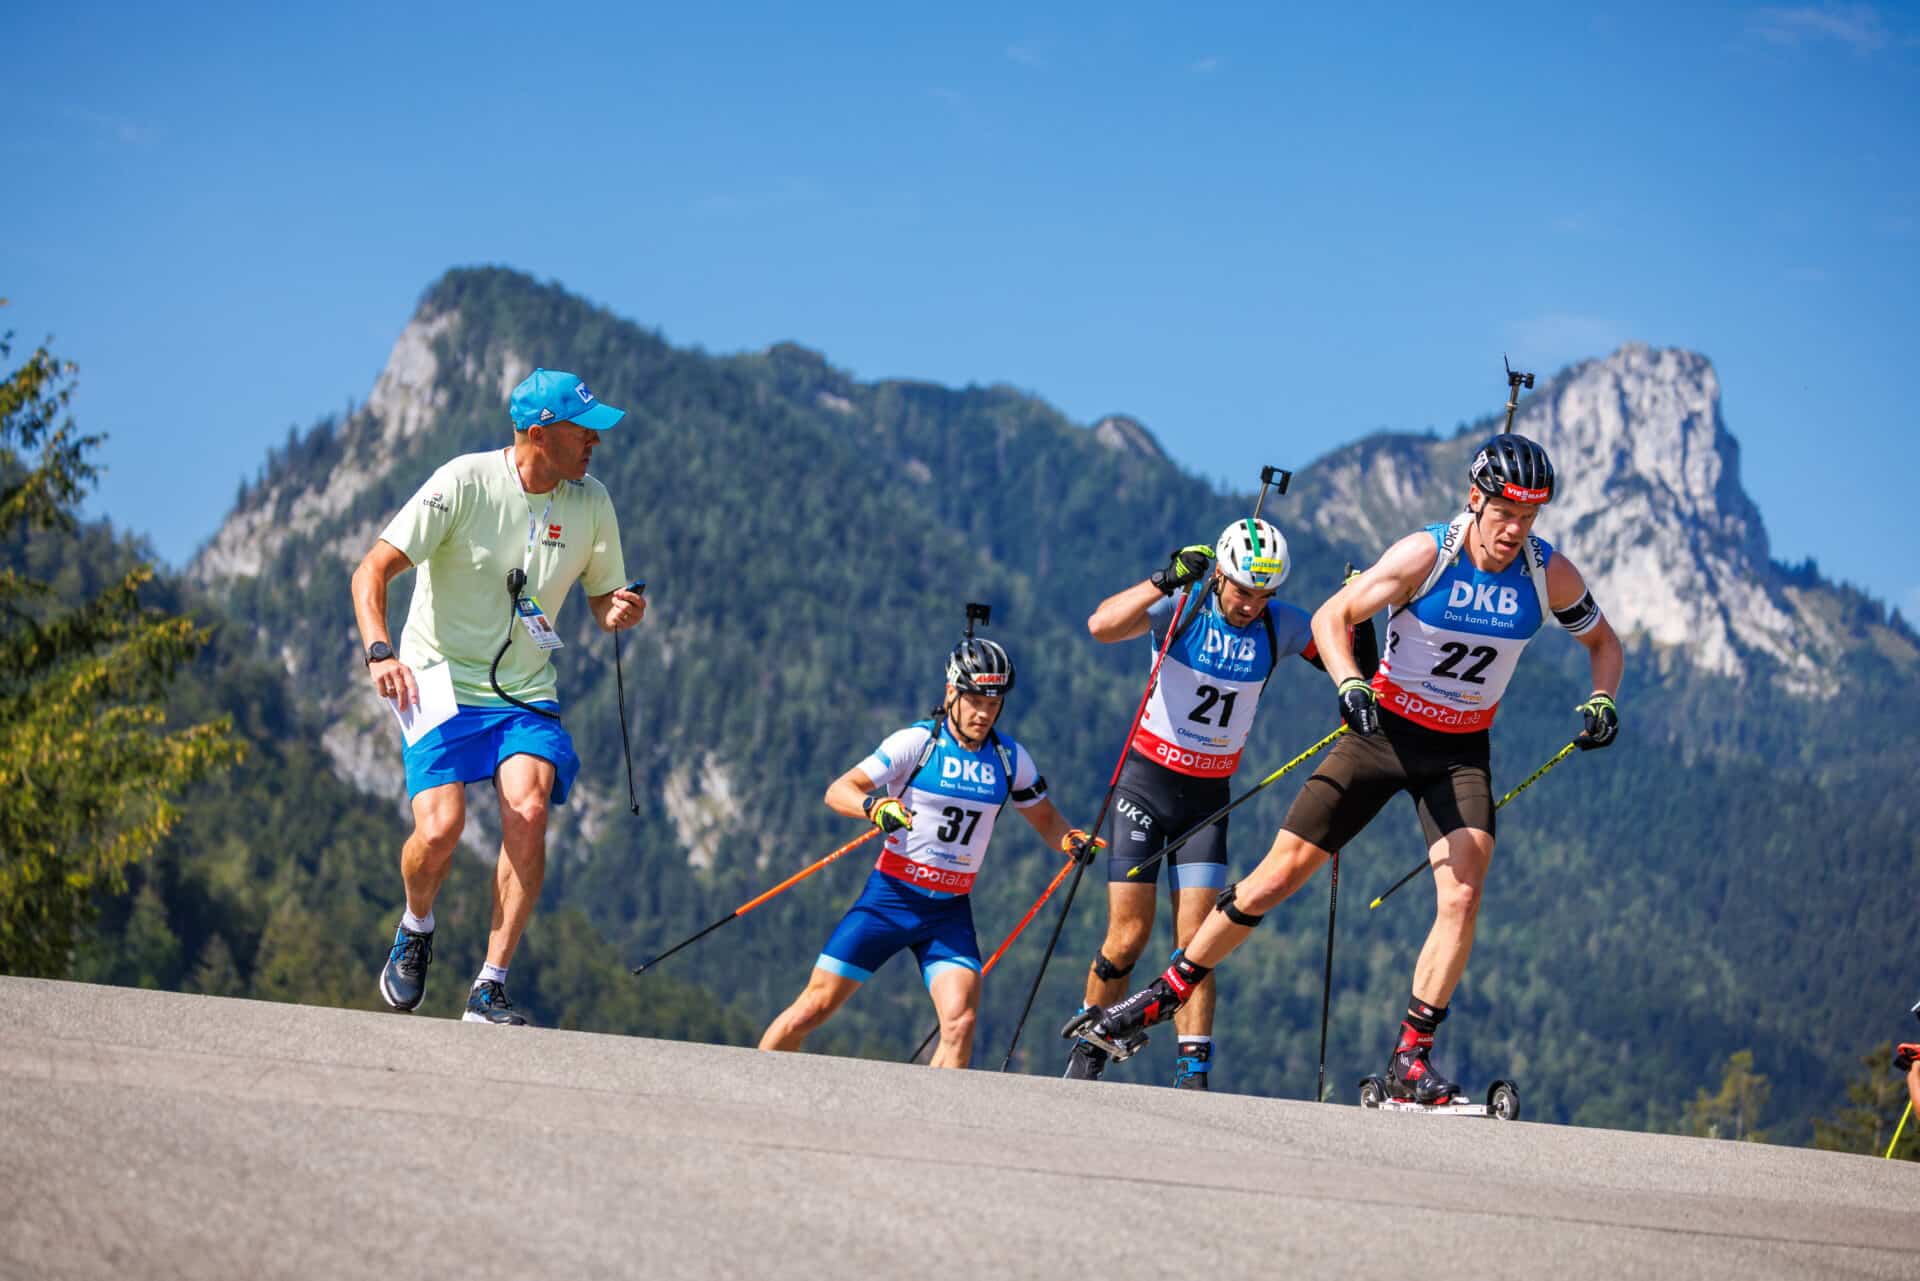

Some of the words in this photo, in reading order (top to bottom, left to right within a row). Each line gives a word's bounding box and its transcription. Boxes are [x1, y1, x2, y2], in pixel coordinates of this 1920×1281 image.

[1442, 523, 1462, 553] JOKA
[1448, 580, 1518, 615] DKB
[1444, 611, 1462, 621] Das
[1465, 614, 1488, 625] kann
[1491, 617, 1515, 629] Bank
[1203, 628, 1256, 661] DKB
[1431, 642, 1498, 684] 22
[1188, 685, 1238, 728] 21
[942, 756, 996, 784] DKB
[937, 806, 983, 846] 37
[1117, 798, 1152, 829] UKR
